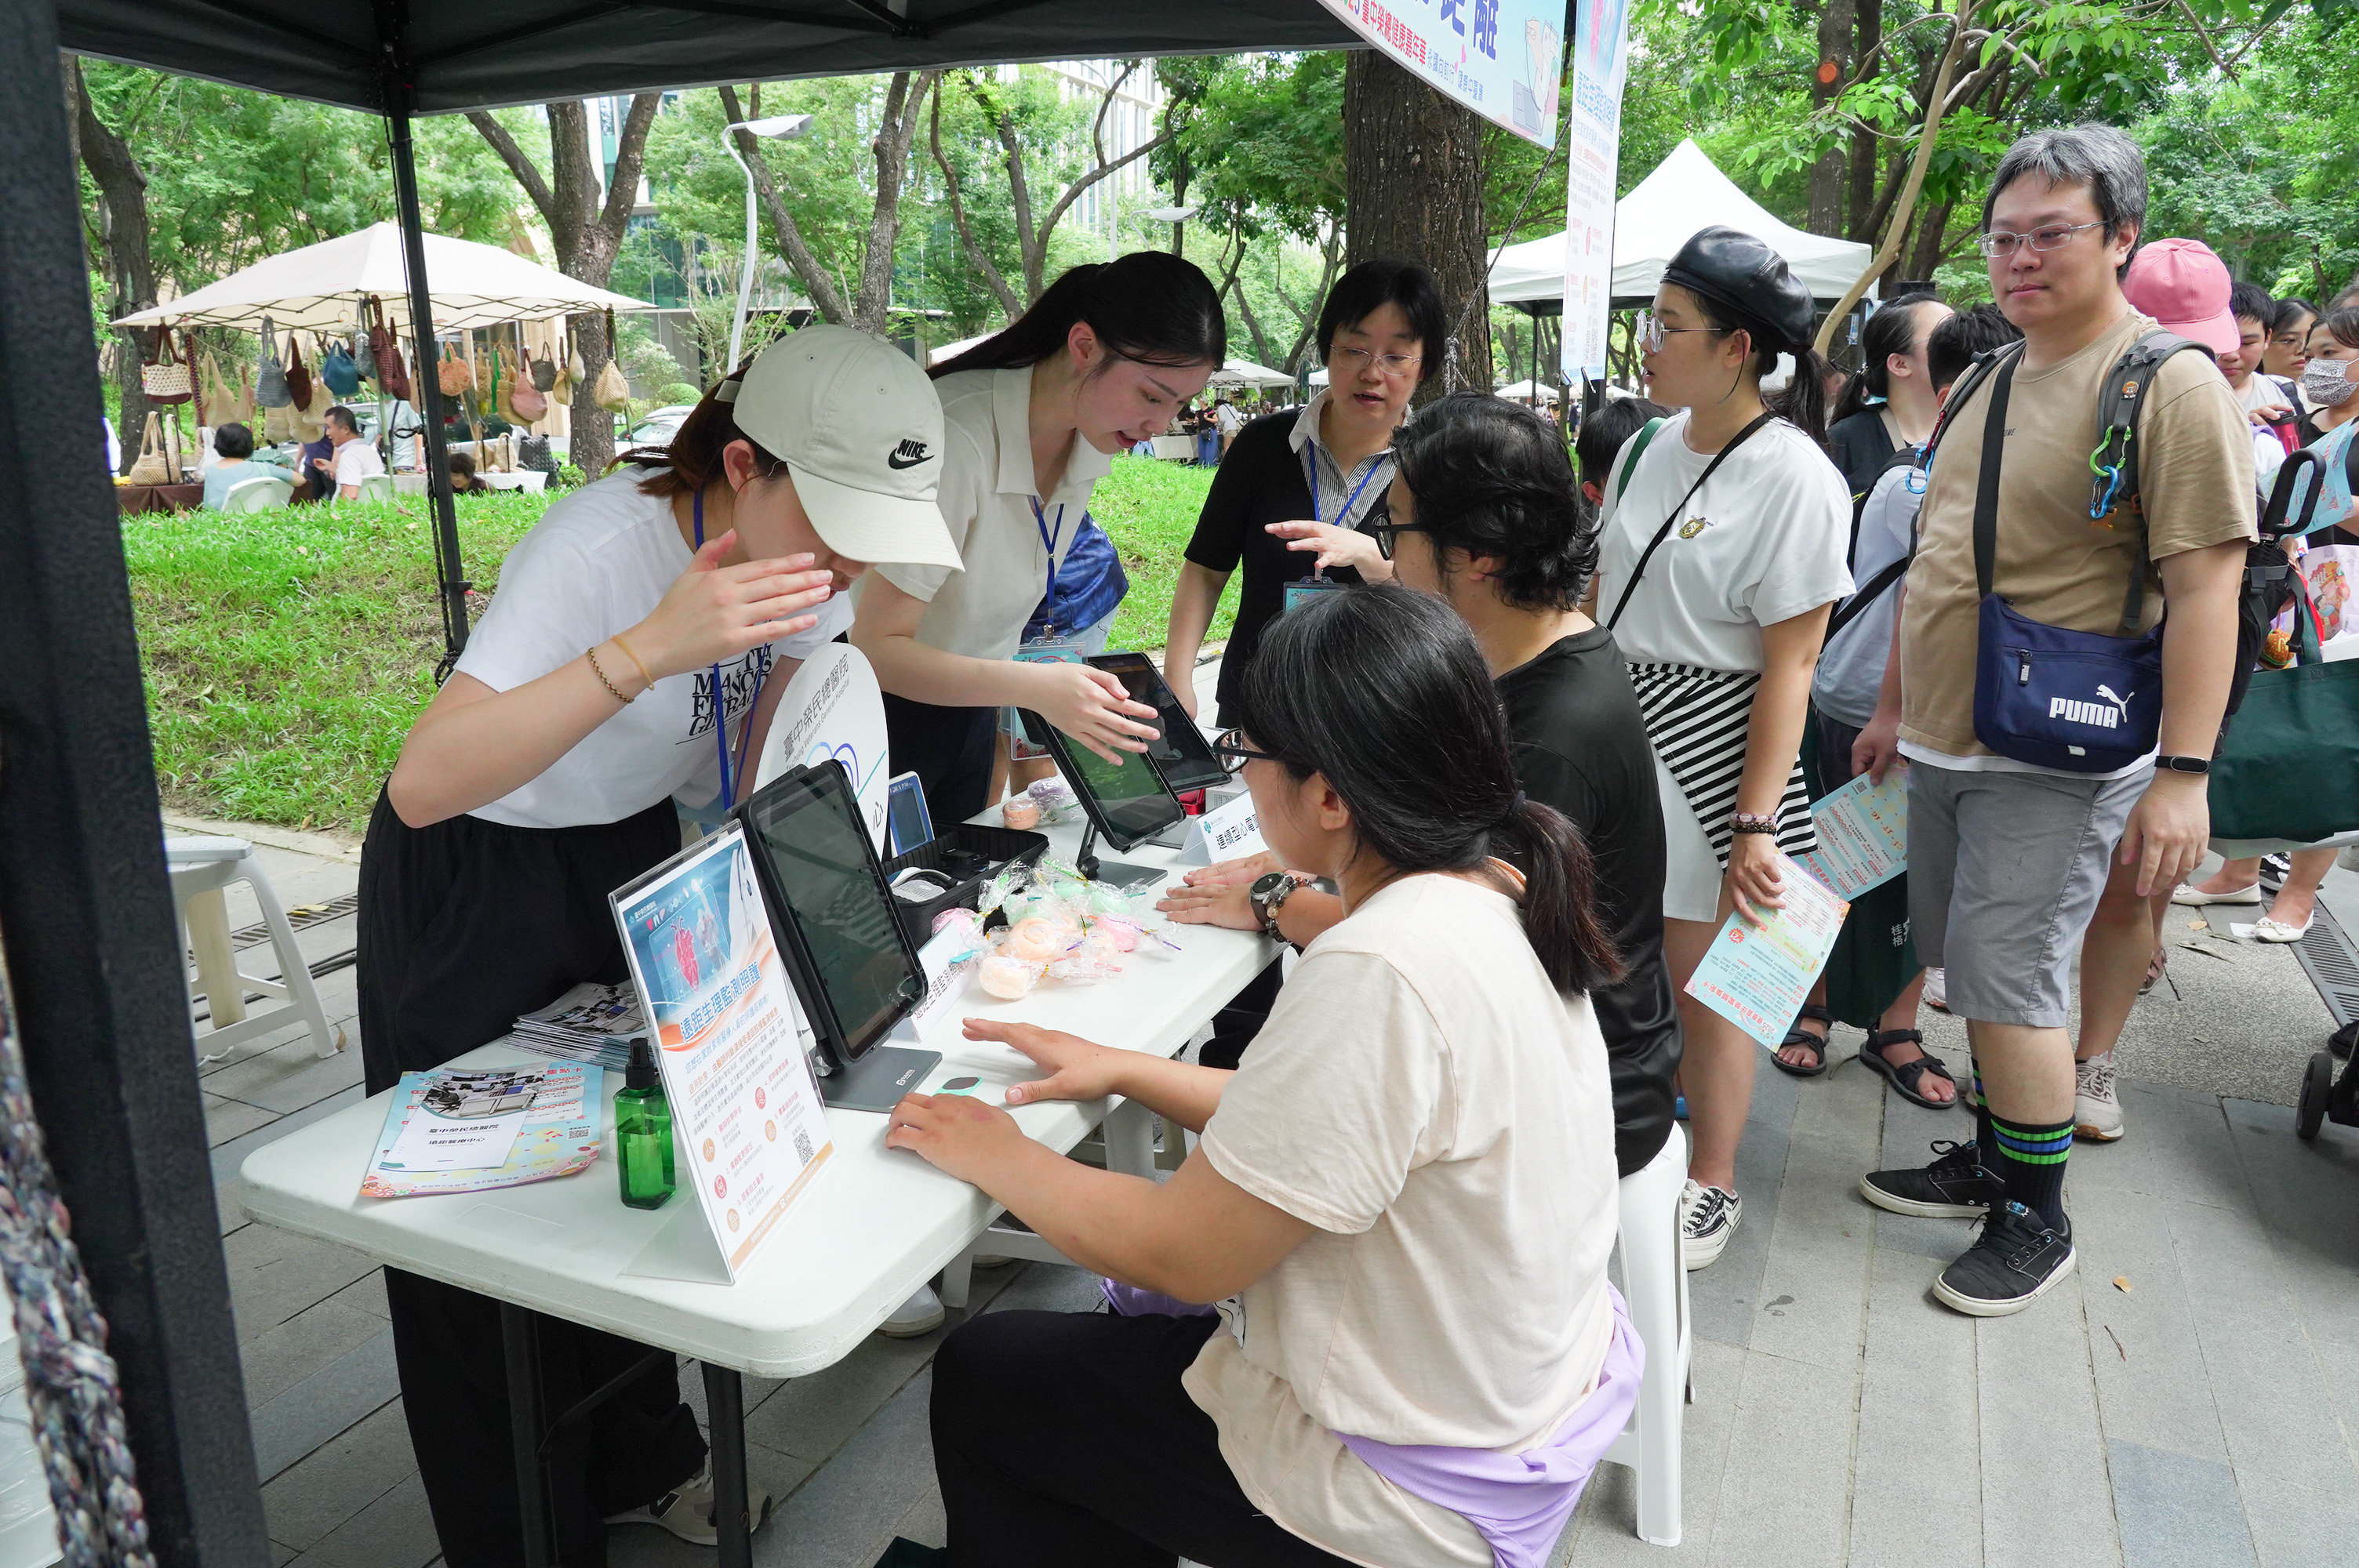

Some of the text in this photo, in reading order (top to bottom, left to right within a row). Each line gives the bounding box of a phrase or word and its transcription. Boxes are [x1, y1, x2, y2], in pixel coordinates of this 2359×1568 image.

[896, 438, 927, 459] NIKE
[783, 653, 849, 763] 臺中榮民總醫院
[804, 723, 822, 746] Veterans
[820, 701, 836, 724] General
[834, 675, 850, 702] Hospital
[2048, 697, 2119, 729] PUMA
[678, 960, 761, 1043] 遠距生理監測照護
[1761, 1021, 1775, 1035] 2025
[546, 1067, 583, 1076] 集點卡
[428, 1123, 500, 1134] 臺中榮民總醫院
